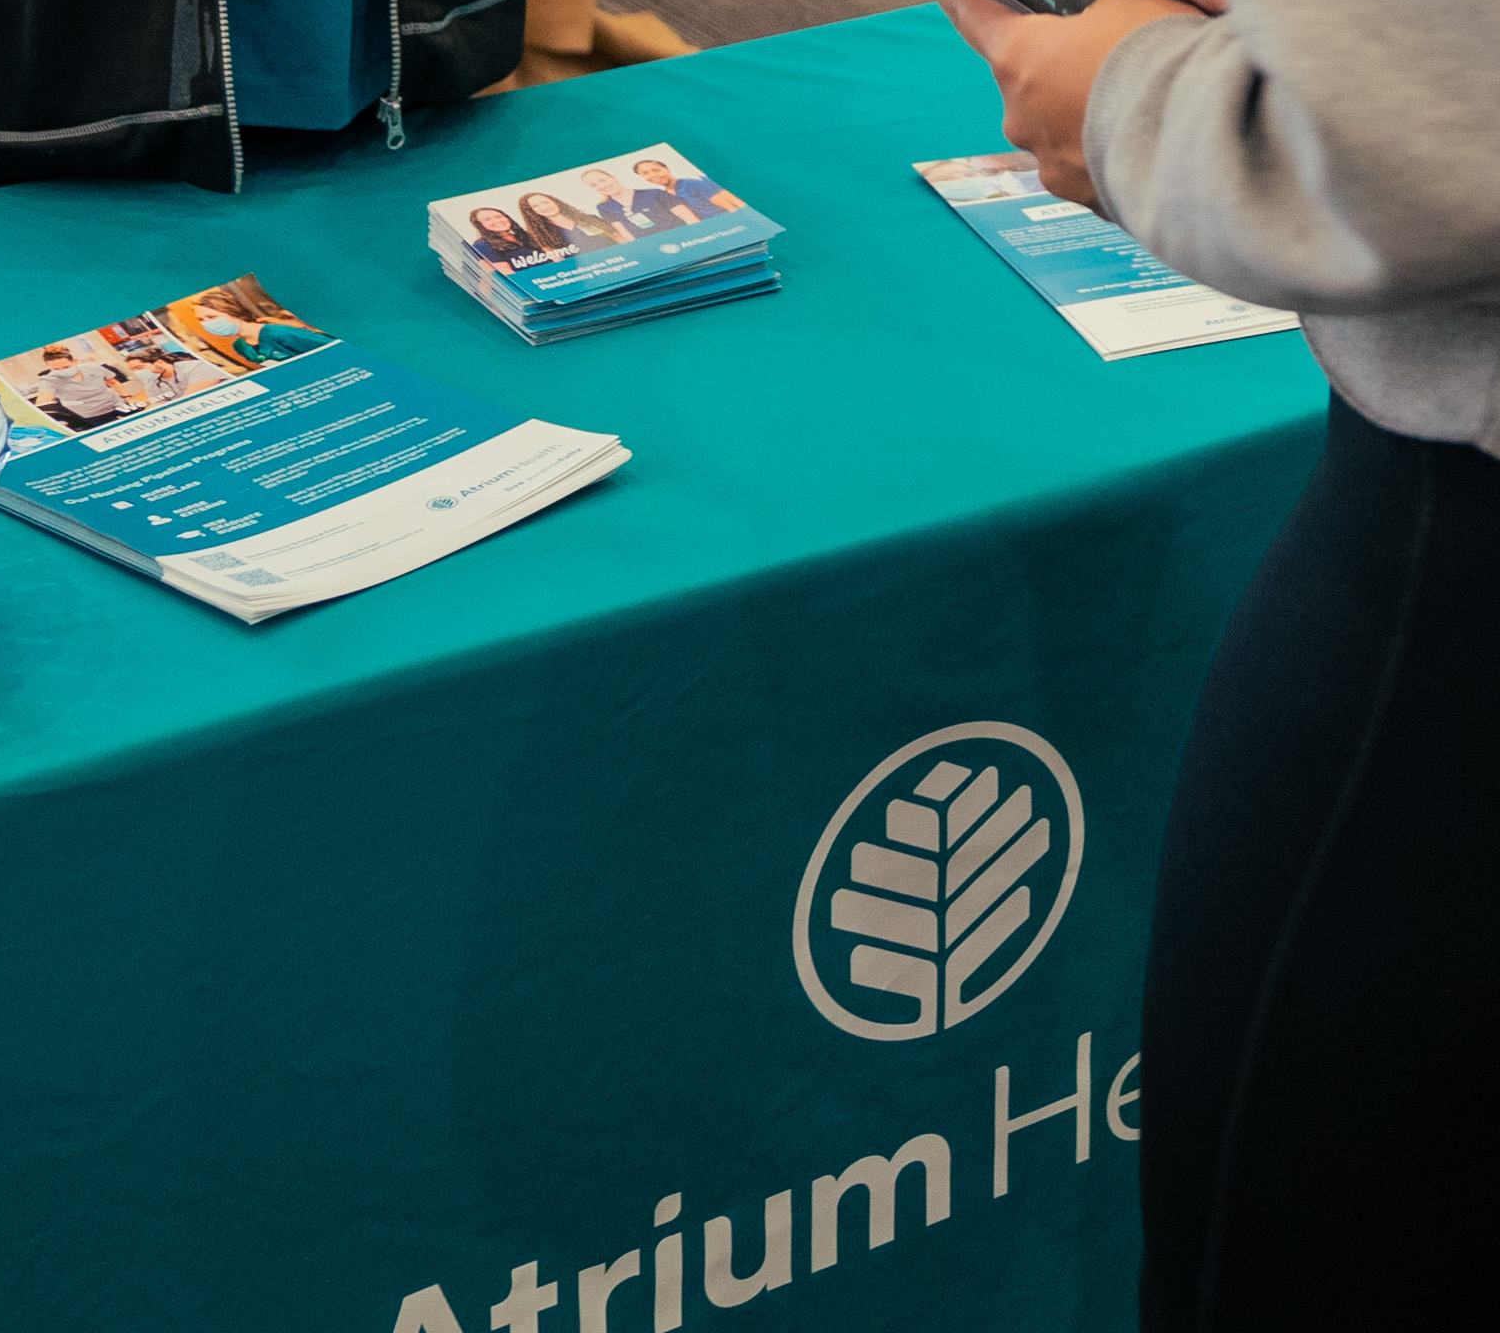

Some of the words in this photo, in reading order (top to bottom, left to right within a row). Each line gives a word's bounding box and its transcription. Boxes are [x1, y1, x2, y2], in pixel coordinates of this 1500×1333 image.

[511, 242, 580, 271] Welcome
[539, 274, 592, 291] Residency
[593, 260, 639, 279] Program
[554, 262, 604, 280] Graduate
[103, 415, 173, 444] ATRIUM
[173, 389, 246, 418] HEALTH
[90, 481, 143, 500] Nursing
[143, 462, 194, 484] Pipeline
[192, 440, 253, 464] Programs
[460, 468, 515, 497] Atrium
[514, 442, 563, 472] Health
